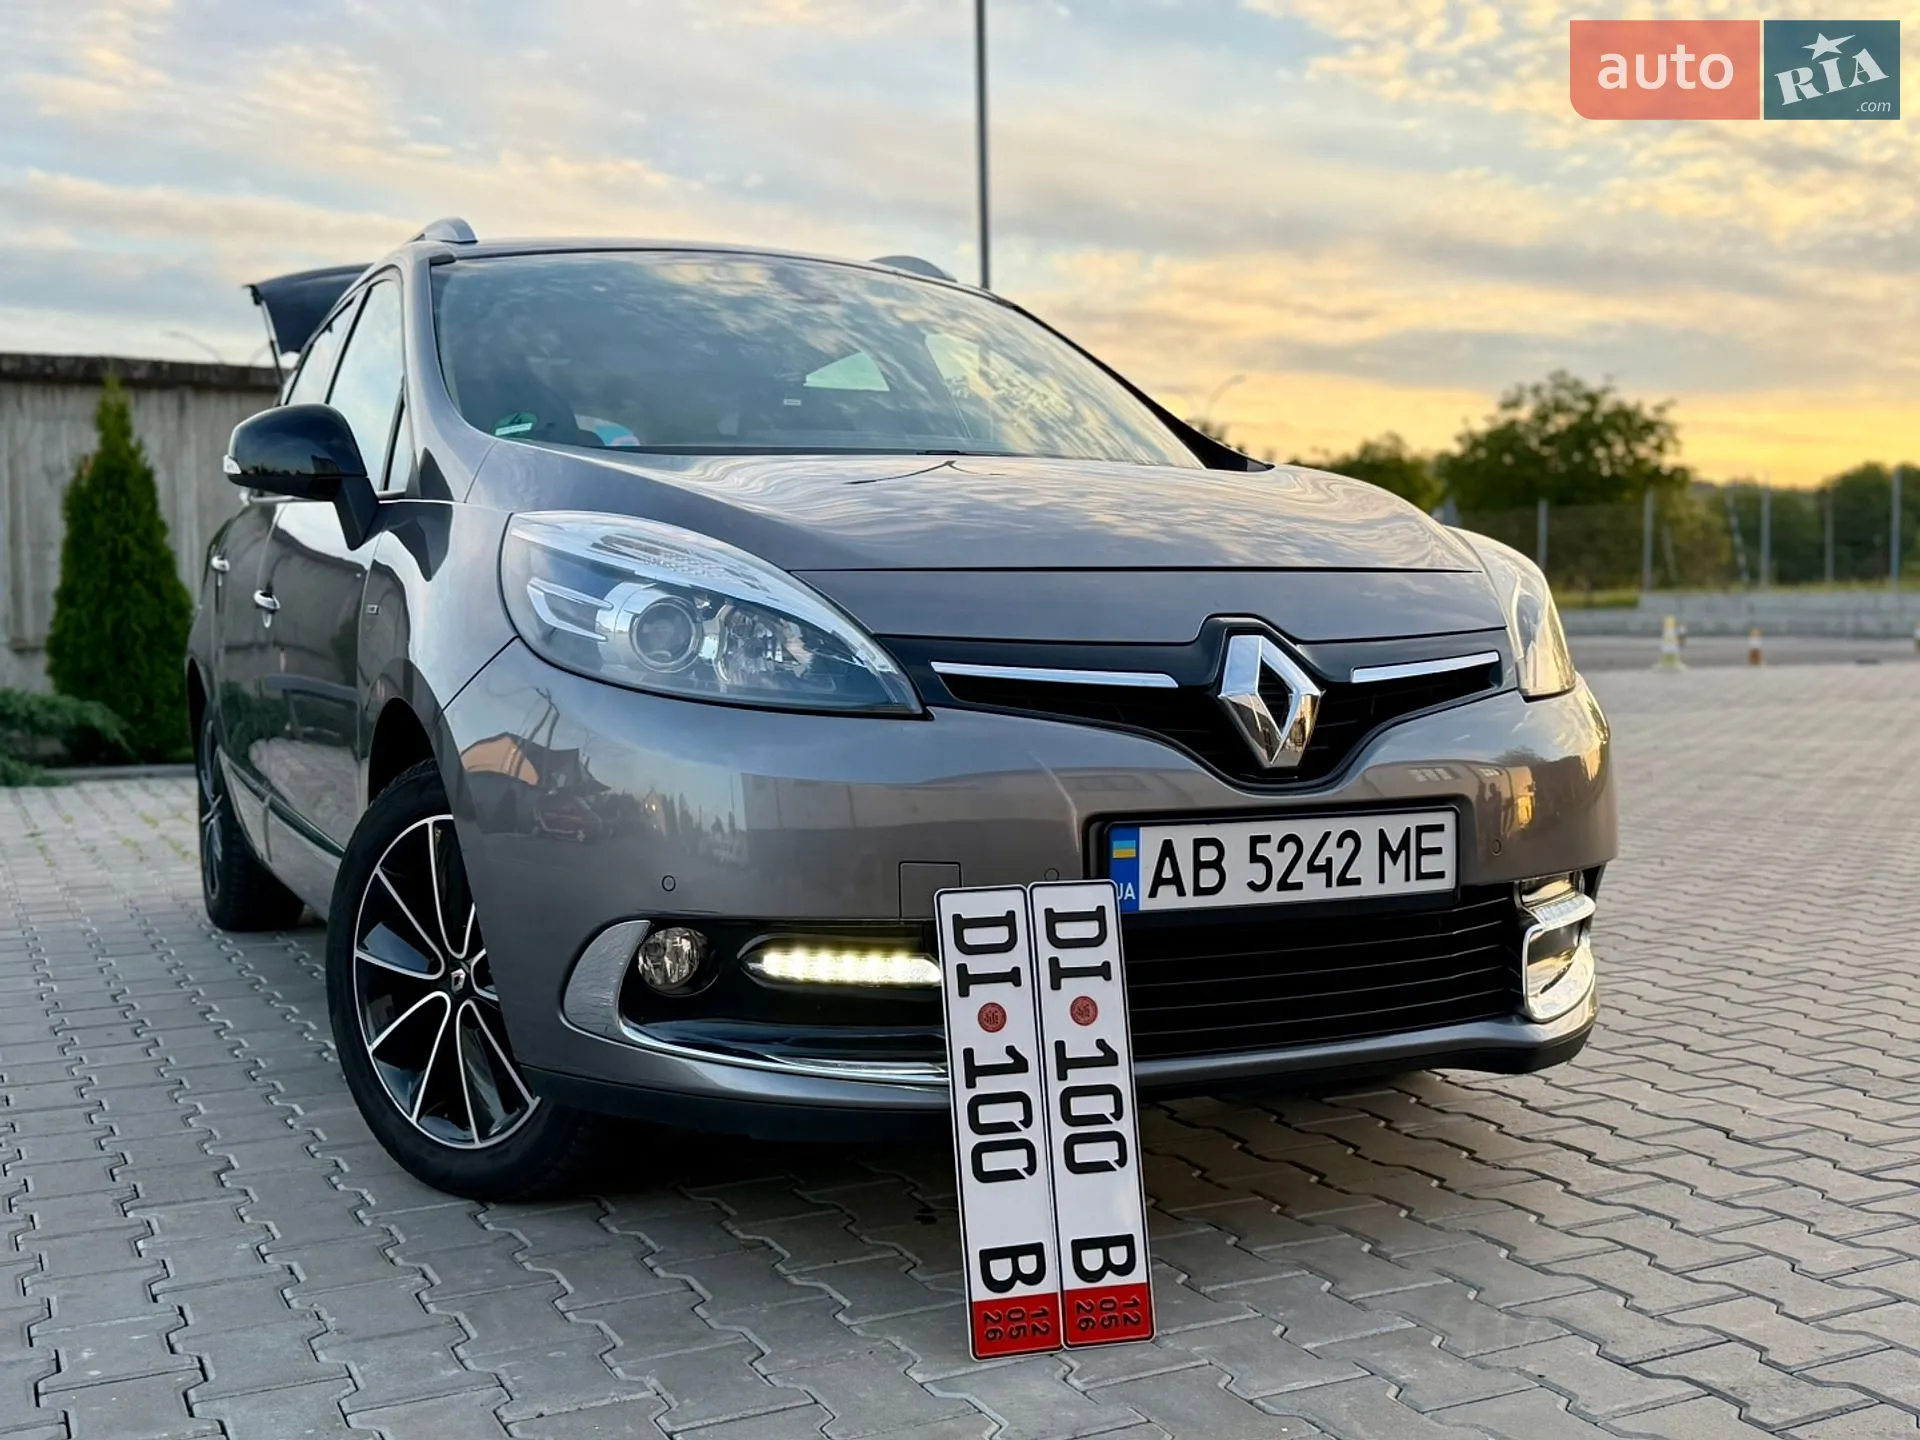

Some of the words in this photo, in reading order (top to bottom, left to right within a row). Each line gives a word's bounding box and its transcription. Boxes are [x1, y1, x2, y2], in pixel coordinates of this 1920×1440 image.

[1147, 838, 1226, 897] AB
[1247, 829, 1362, 893] 5242
[1378, 823, 1446, 884] ME
[952, 910, 1022, 998] DI
[1044, 905, 1112, 990] DI
[963, 1045, 1037, 1183] 100
[1054, 1038, 1128, 1175] 100
[979, 1241, 1046, 1294] B
[1071, 1233, 1136, 1283] B
[983, 1309, 1004, 1342] 26
[1006, 1306, 1027, 1339] 05
[1029, 1306, 1050, 1336] 12
[1076, 1299, 1096, 1332] 26
[1099, 1296, 1119, 1329] 05
[1122, 1295, 1143, 1327] 12
